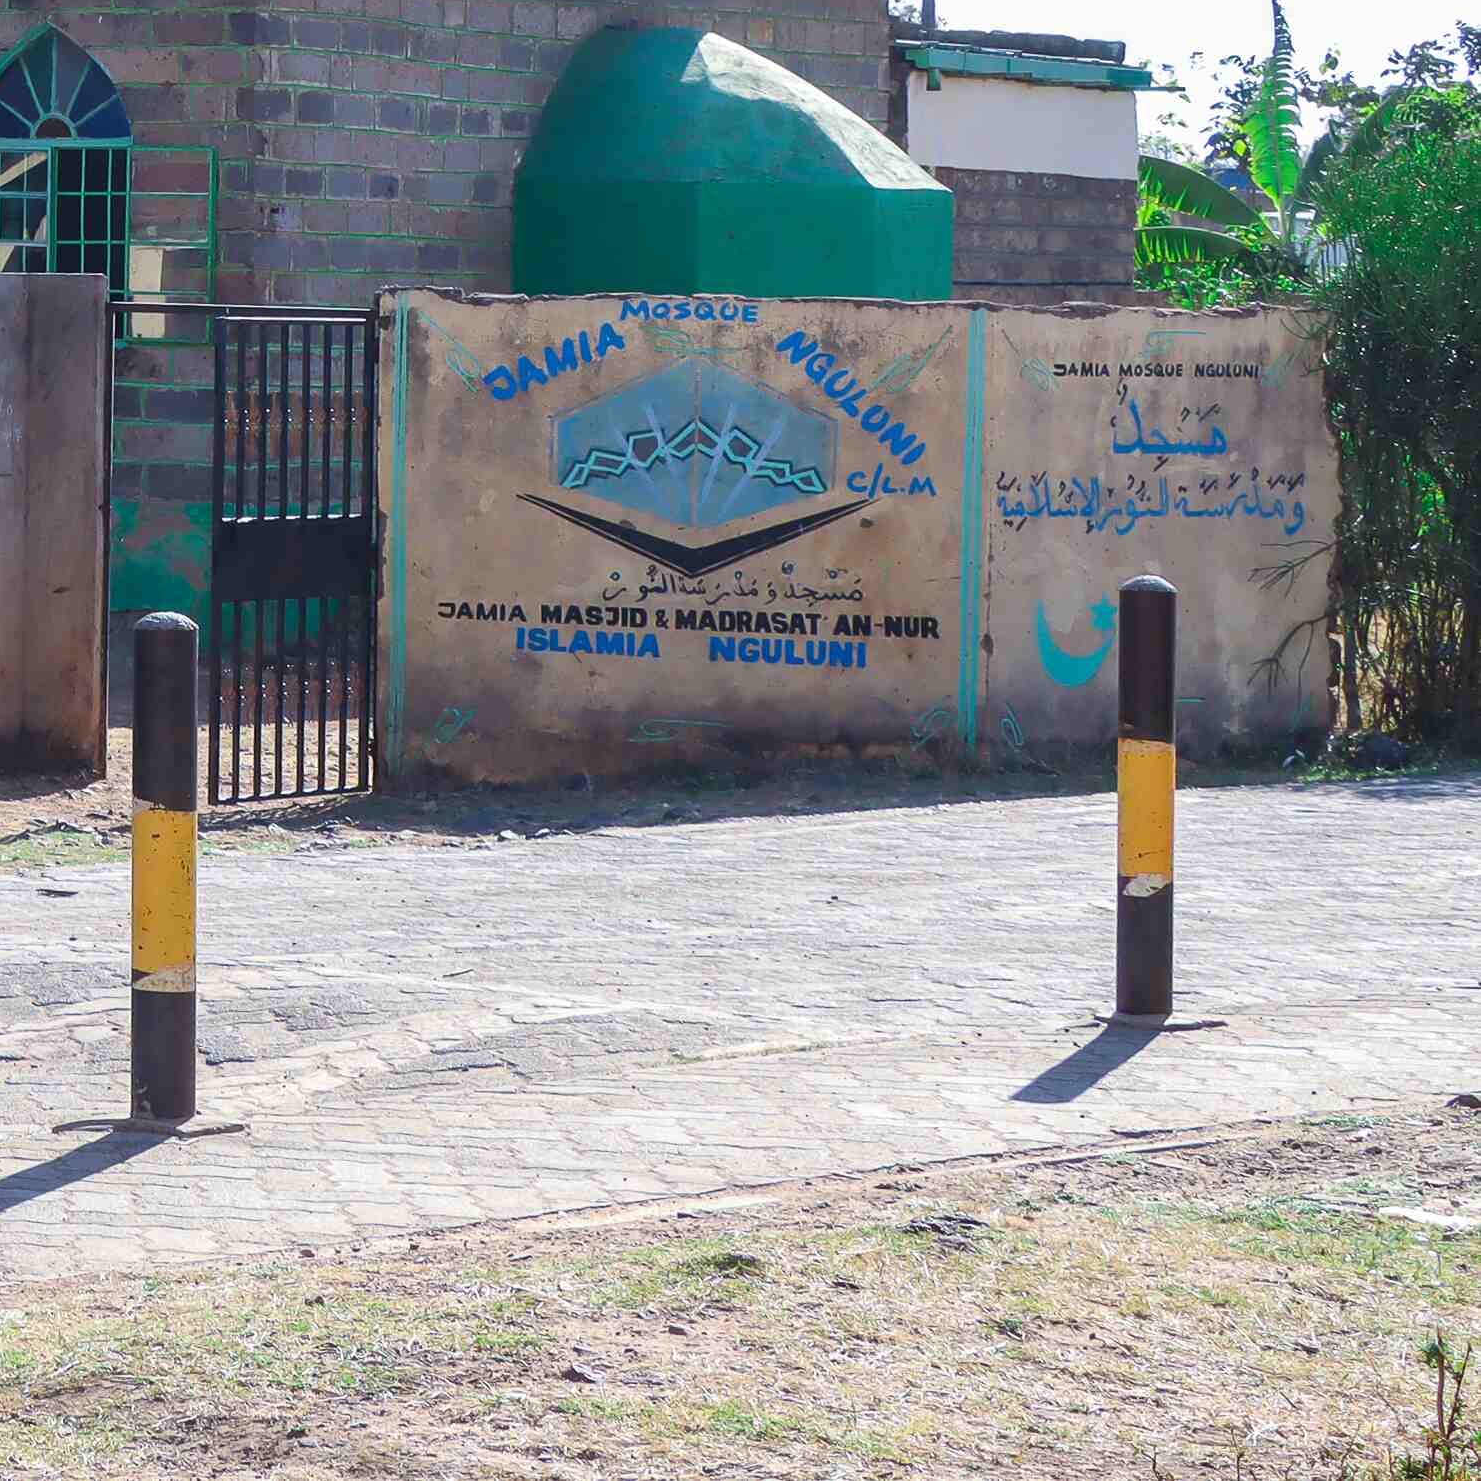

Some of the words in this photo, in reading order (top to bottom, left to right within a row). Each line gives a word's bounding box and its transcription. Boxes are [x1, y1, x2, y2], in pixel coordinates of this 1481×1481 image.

[483, 322, 626, 400] JAMIA
[620, 299, 759, 322] MOSQUE
[776, 330, 926, 465] NGULUNI
[1052, 361, 1111, 378] JAMIA
[1118, 362, 1183, 378] MOSQUE
[1193, 363, 1261, 379] NGULUNI
[438, 601, 527, 623] JAMIA
[540, 603, 649, 629] MASJID
[655, 609, 670, 630] &
[674, 608, 822, 636] MADRASAT
[833, 613, 940, 639] AN-NUR
[515, 626, 661, 658] ISLAMIA
[708, 635, 868, 668] NGULUNI
